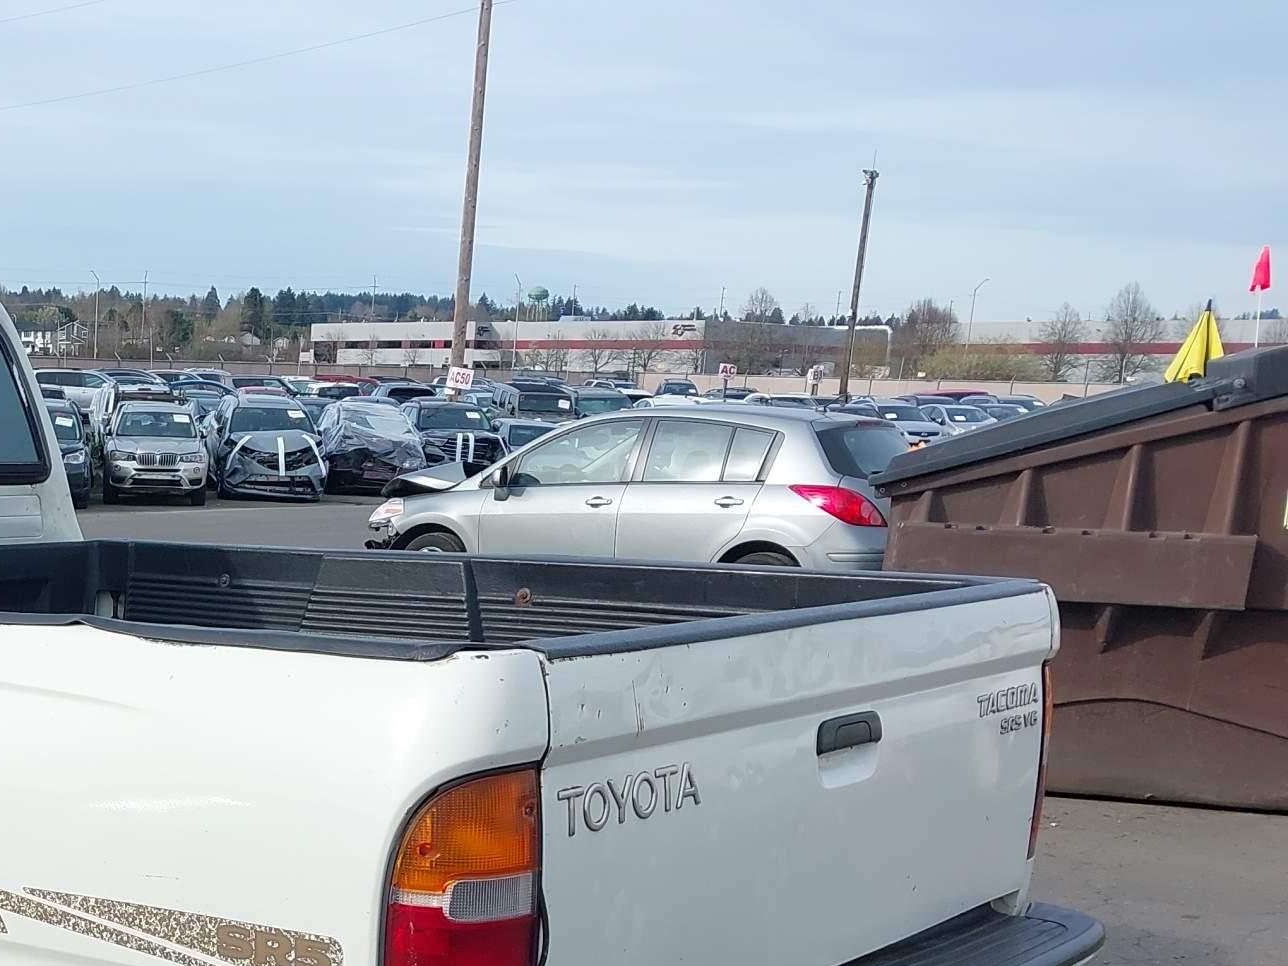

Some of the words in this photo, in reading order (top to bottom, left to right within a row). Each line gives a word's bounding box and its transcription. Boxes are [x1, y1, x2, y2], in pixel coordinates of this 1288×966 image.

[449, 371, 471, 384] AC50
[977, 682, 1039, 718] TACOMA
[557, 762, 701, 837] TOYOTA
